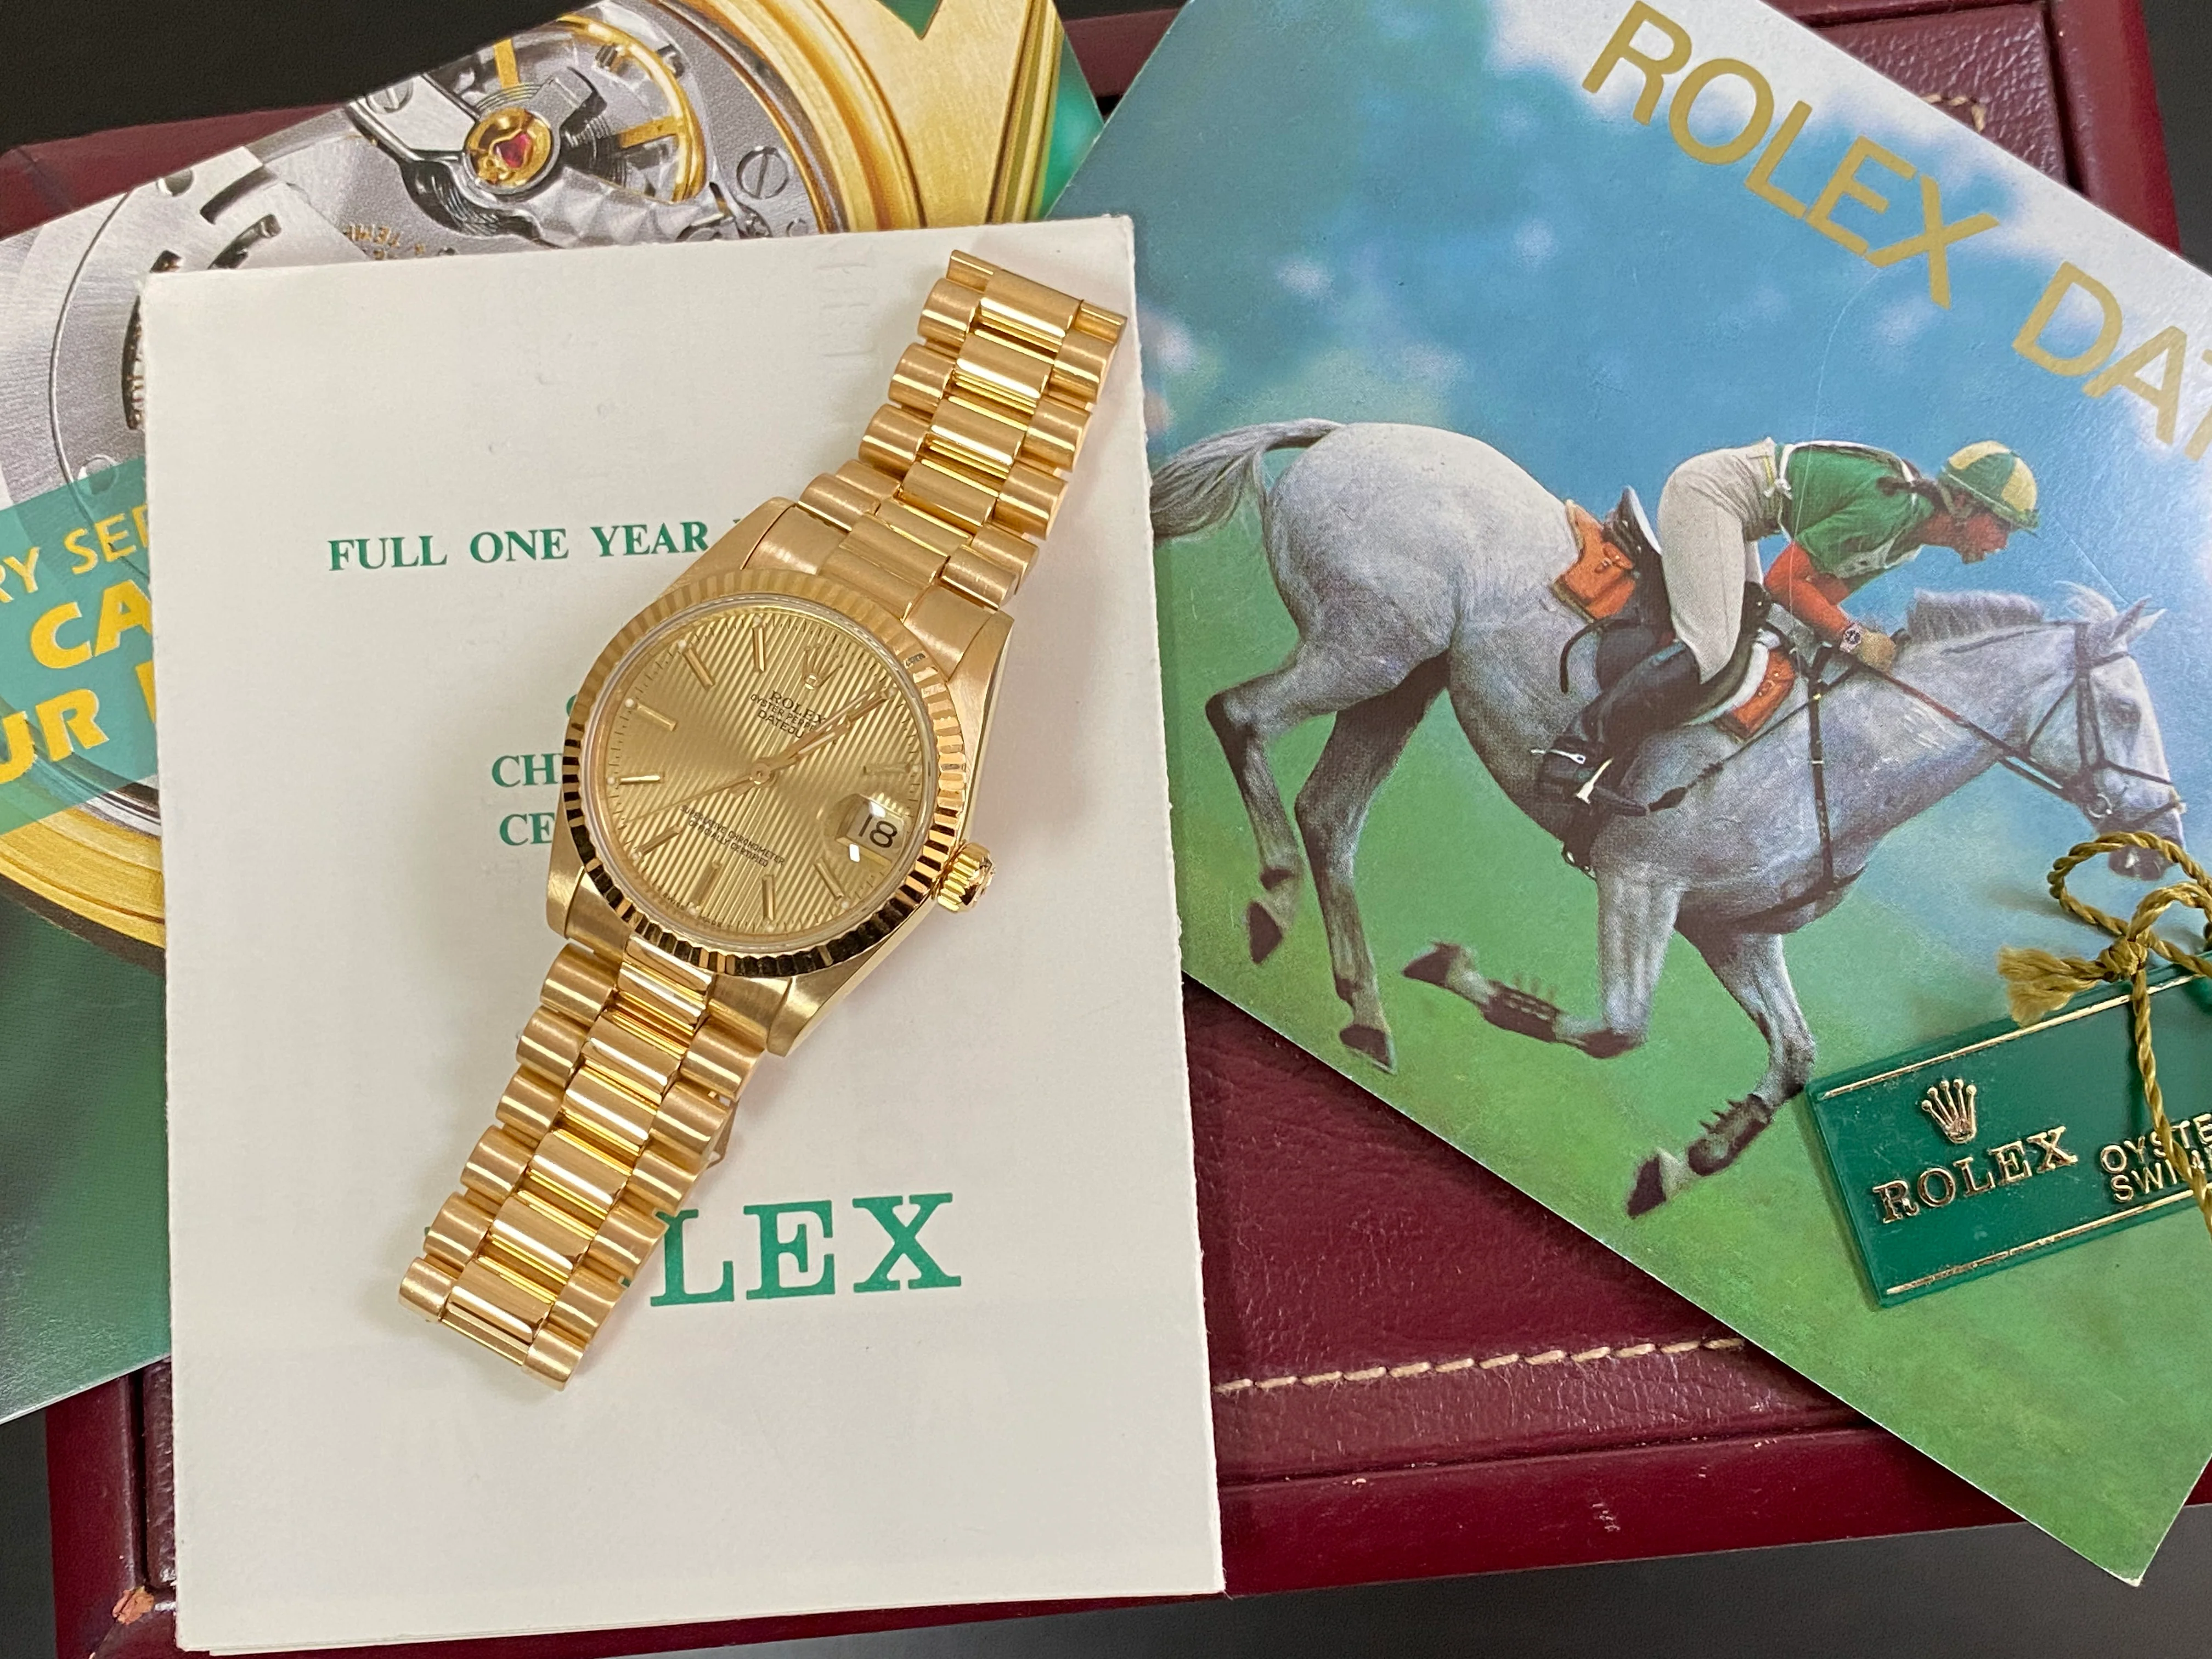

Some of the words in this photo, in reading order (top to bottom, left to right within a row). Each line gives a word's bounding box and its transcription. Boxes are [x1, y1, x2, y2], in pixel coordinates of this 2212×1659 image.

[1582, 0, 2000, 309] ROLEX
[328, 534, 448, 572] FULL
[470, 528, 569, 563] ONE
[590, 521, 710, 557] YEAR
[750, 693, 785, 717] OYSTER
[770, 690, 826, 724] ROLEX
[758, 709, 804, 738] DATEJU
[858, 813, 898, 848] 18
[728, 831, 785, 866] CHRONOMETER
[730, 842, 769, 867] CERTIFIED
[1872, 1125, 2079, 1224] ROLEX
[620, 1192, 962, 1307] LEX
